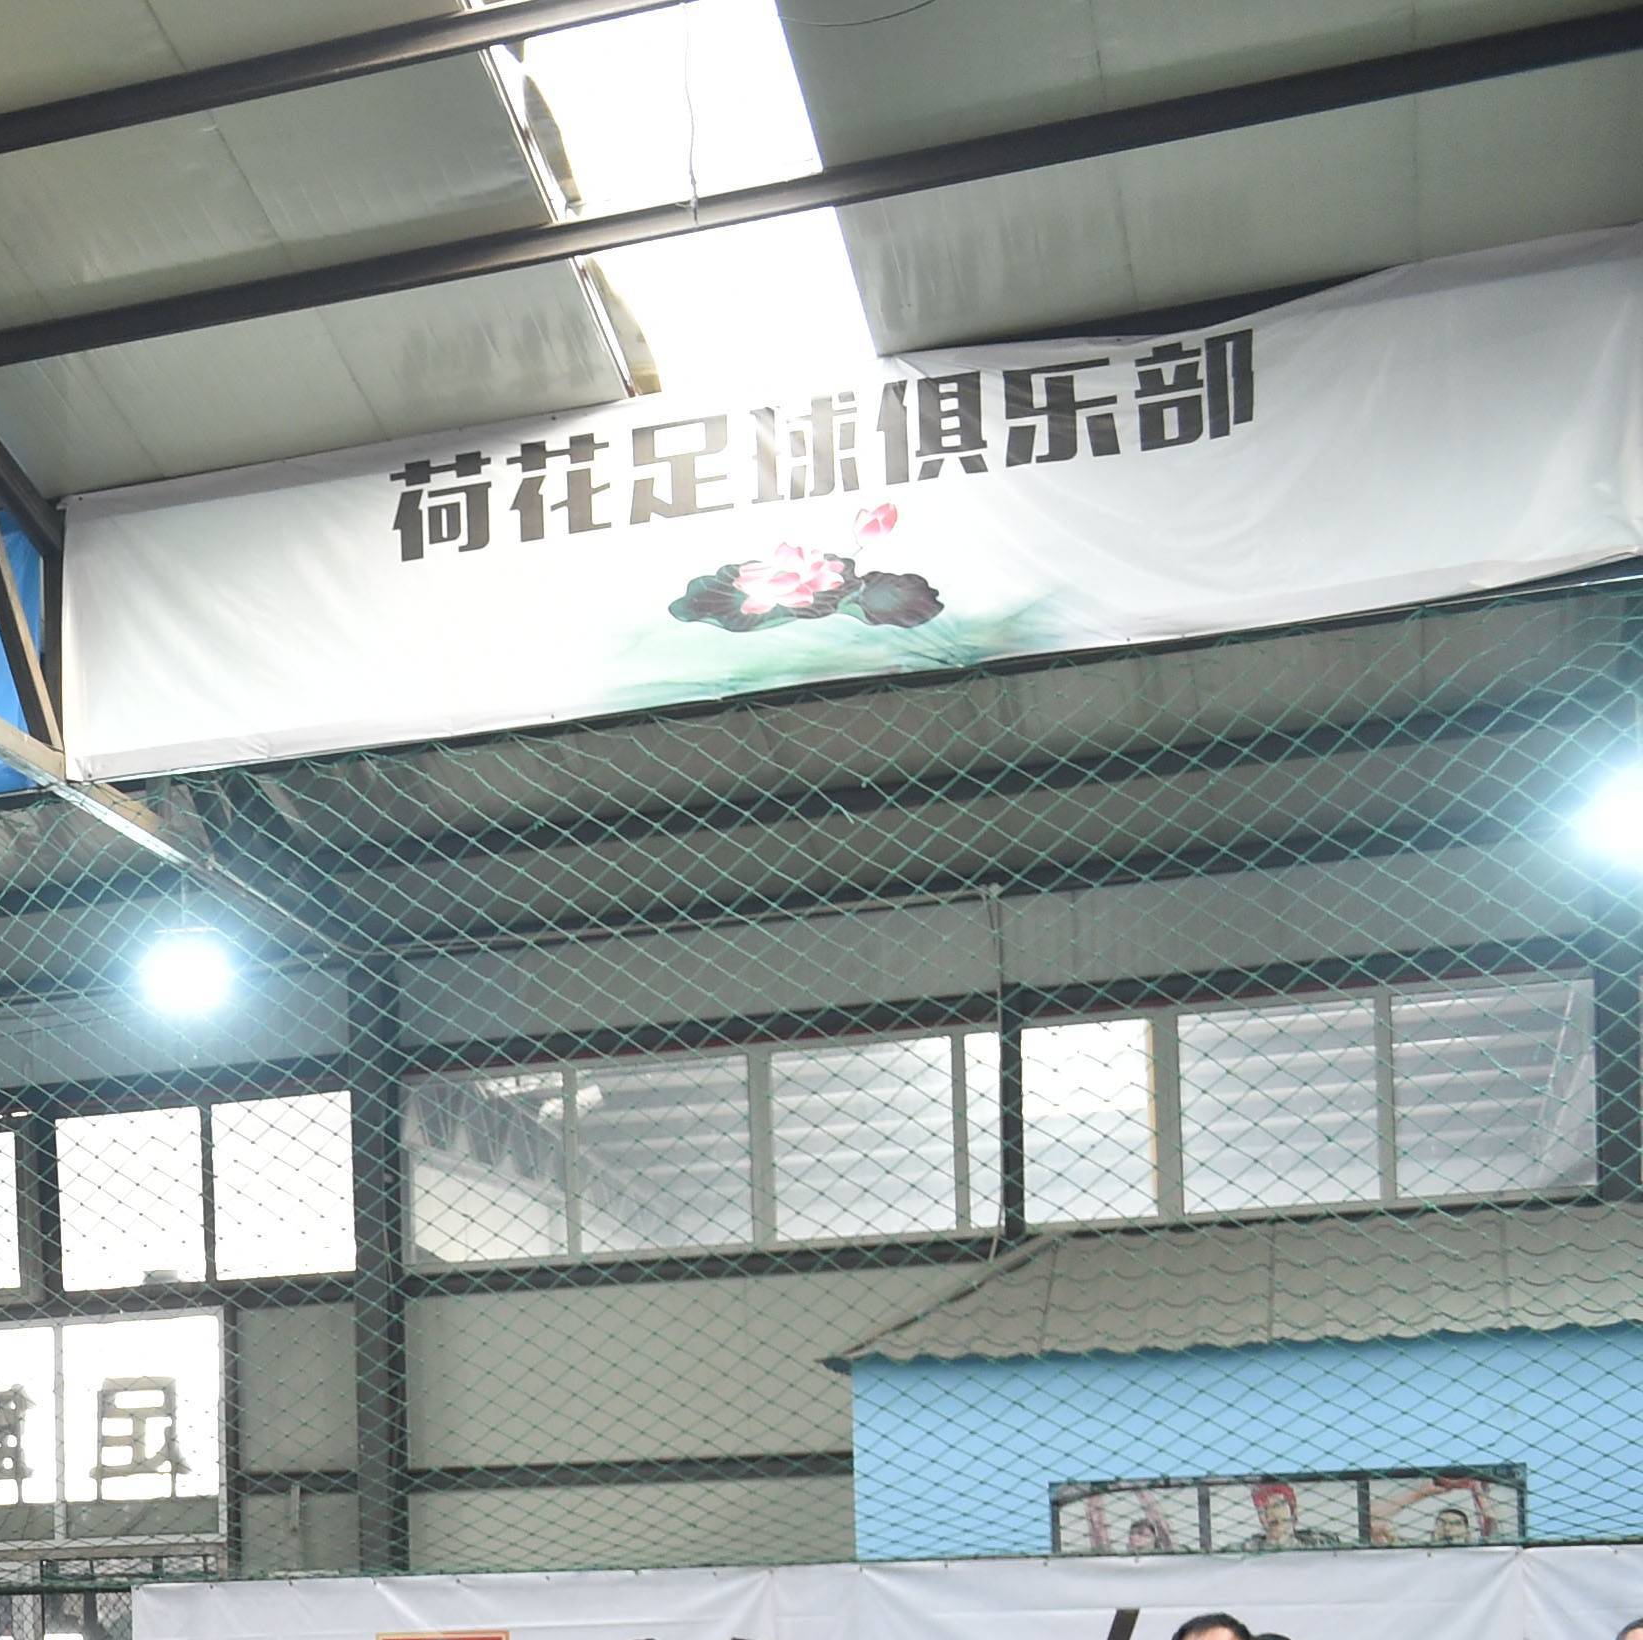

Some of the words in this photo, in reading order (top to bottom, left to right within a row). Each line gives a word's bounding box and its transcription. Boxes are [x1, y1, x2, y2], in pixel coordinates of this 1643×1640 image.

[391, 326, 1255, 562] 荷花足球俱乐部
